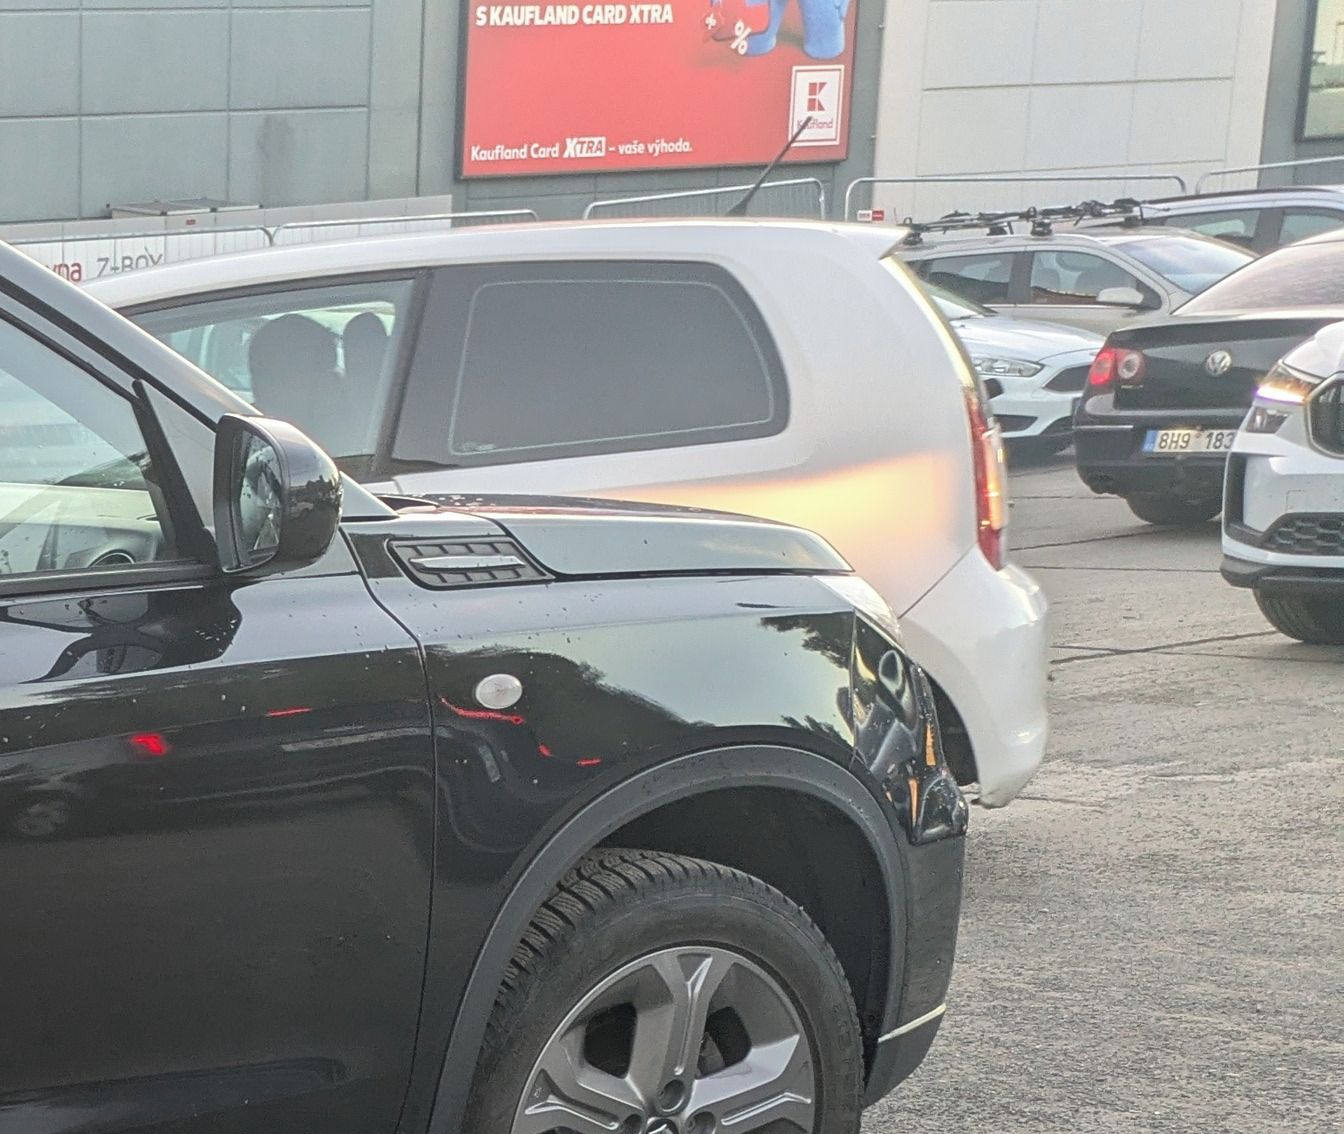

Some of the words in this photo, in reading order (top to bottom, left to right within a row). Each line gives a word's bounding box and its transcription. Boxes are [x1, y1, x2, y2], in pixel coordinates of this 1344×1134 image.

[475, 6, 487, 26] S
[489, 5, 580, 26] KAUFLAND
[582, 4, 627, 25] CARD
[629, 4, 673, 24] XTRA
[797, 118, 833, 130] Kufland
[471, 145, 528, 161] Kaufland
[530, 142, 560, 159] Card
[618, 140, 645, 155] vaše
[647, 138, 693, 157] výhoda.
[1159, 433, 1191, 449] 8H9
[1206, 432, 1233, 449] 183
